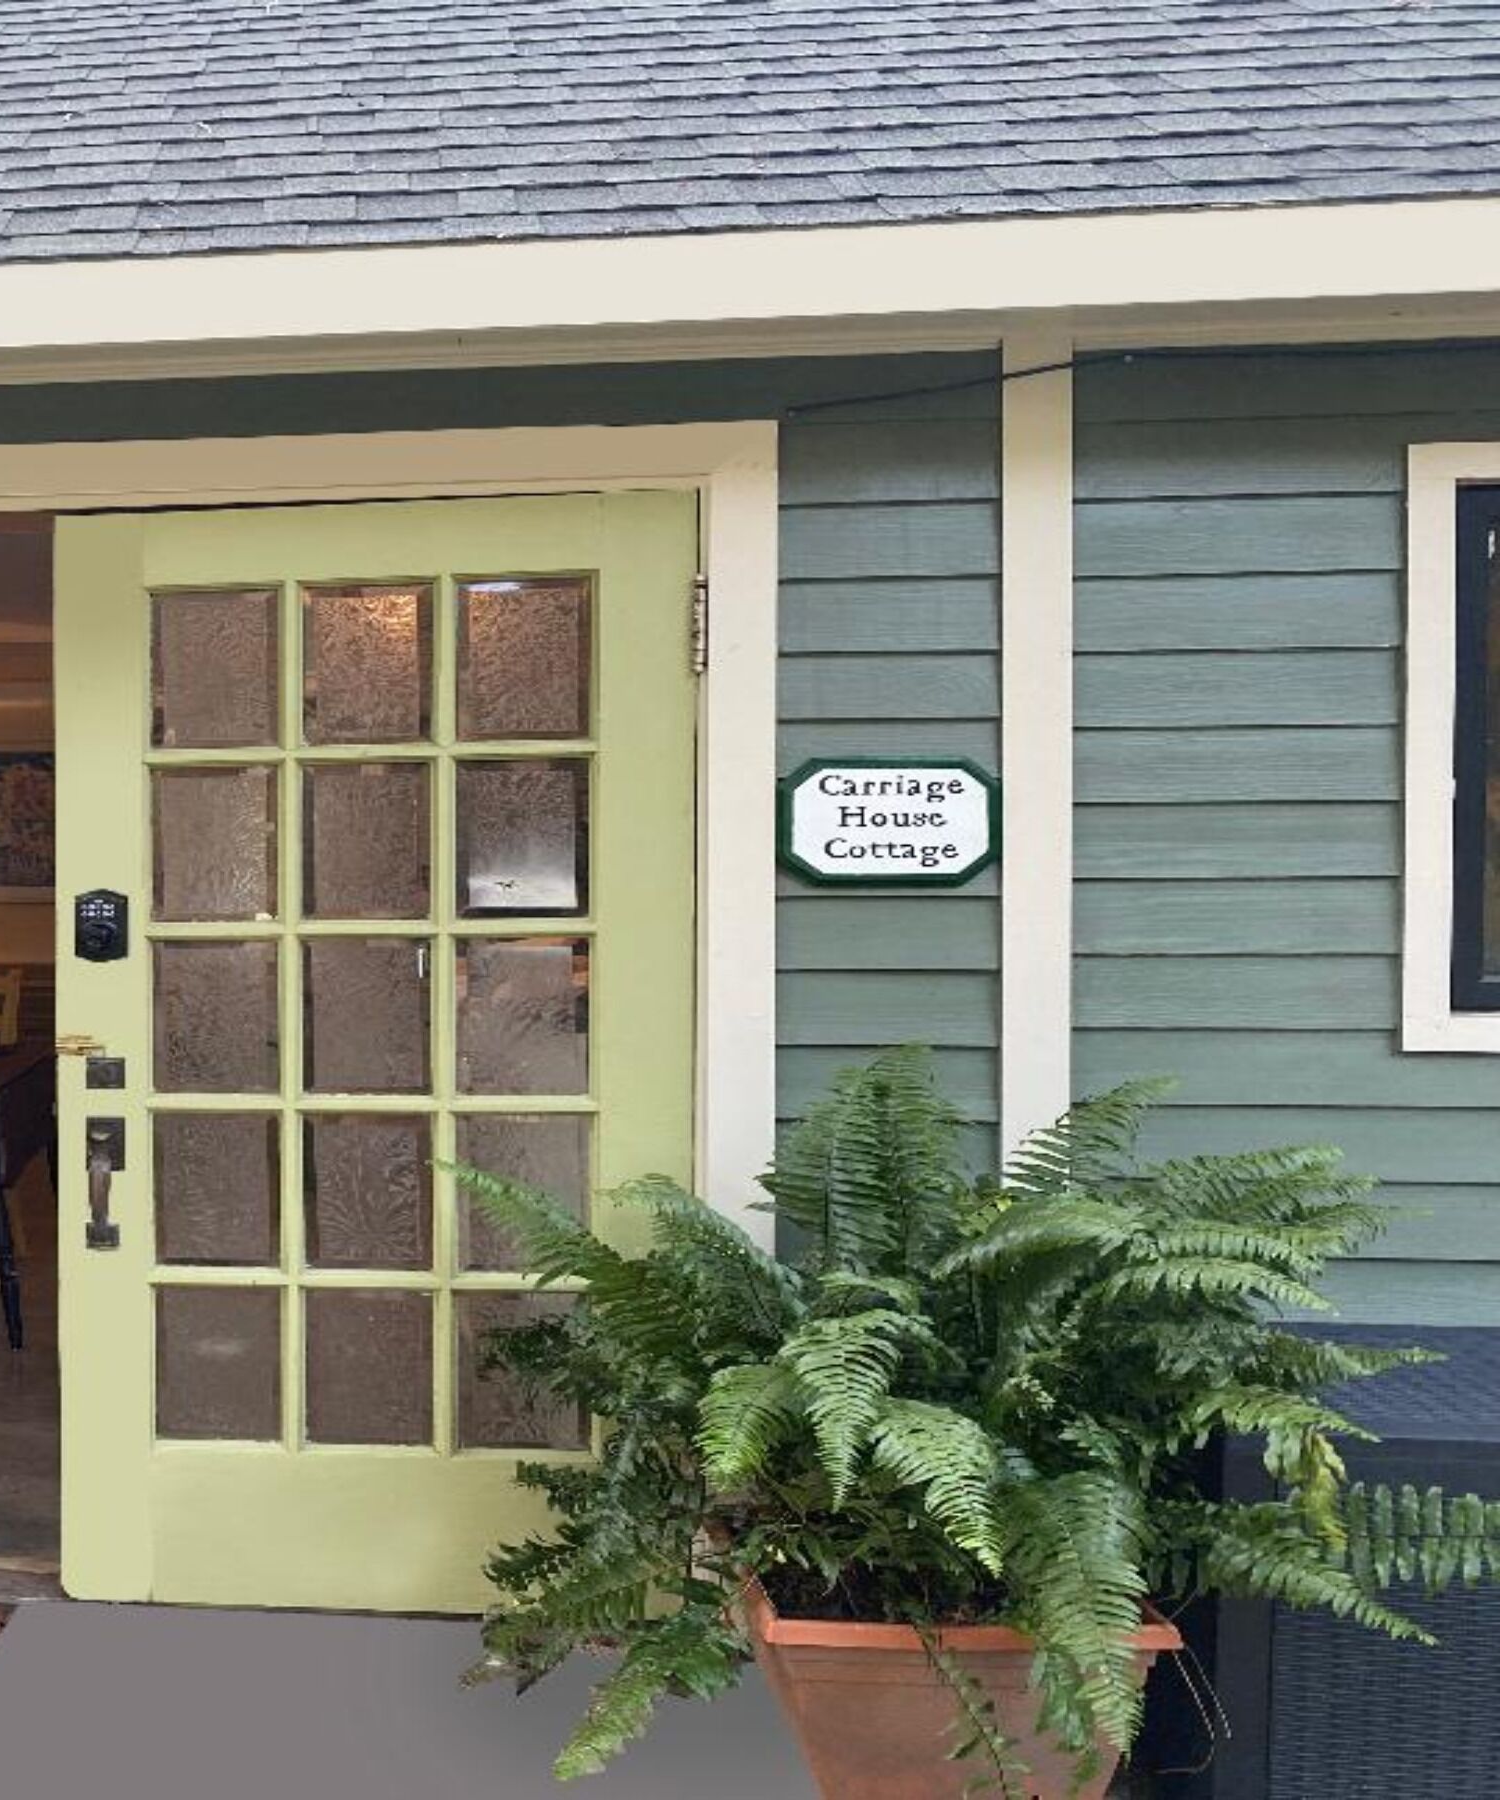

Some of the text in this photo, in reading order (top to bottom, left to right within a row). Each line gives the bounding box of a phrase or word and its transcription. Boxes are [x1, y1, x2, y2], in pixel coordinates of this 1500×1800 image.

[819, 775, 965, 803] Carriage
[838, 806, 947, 828] House
[824, 837, 960, 868] Cottage
